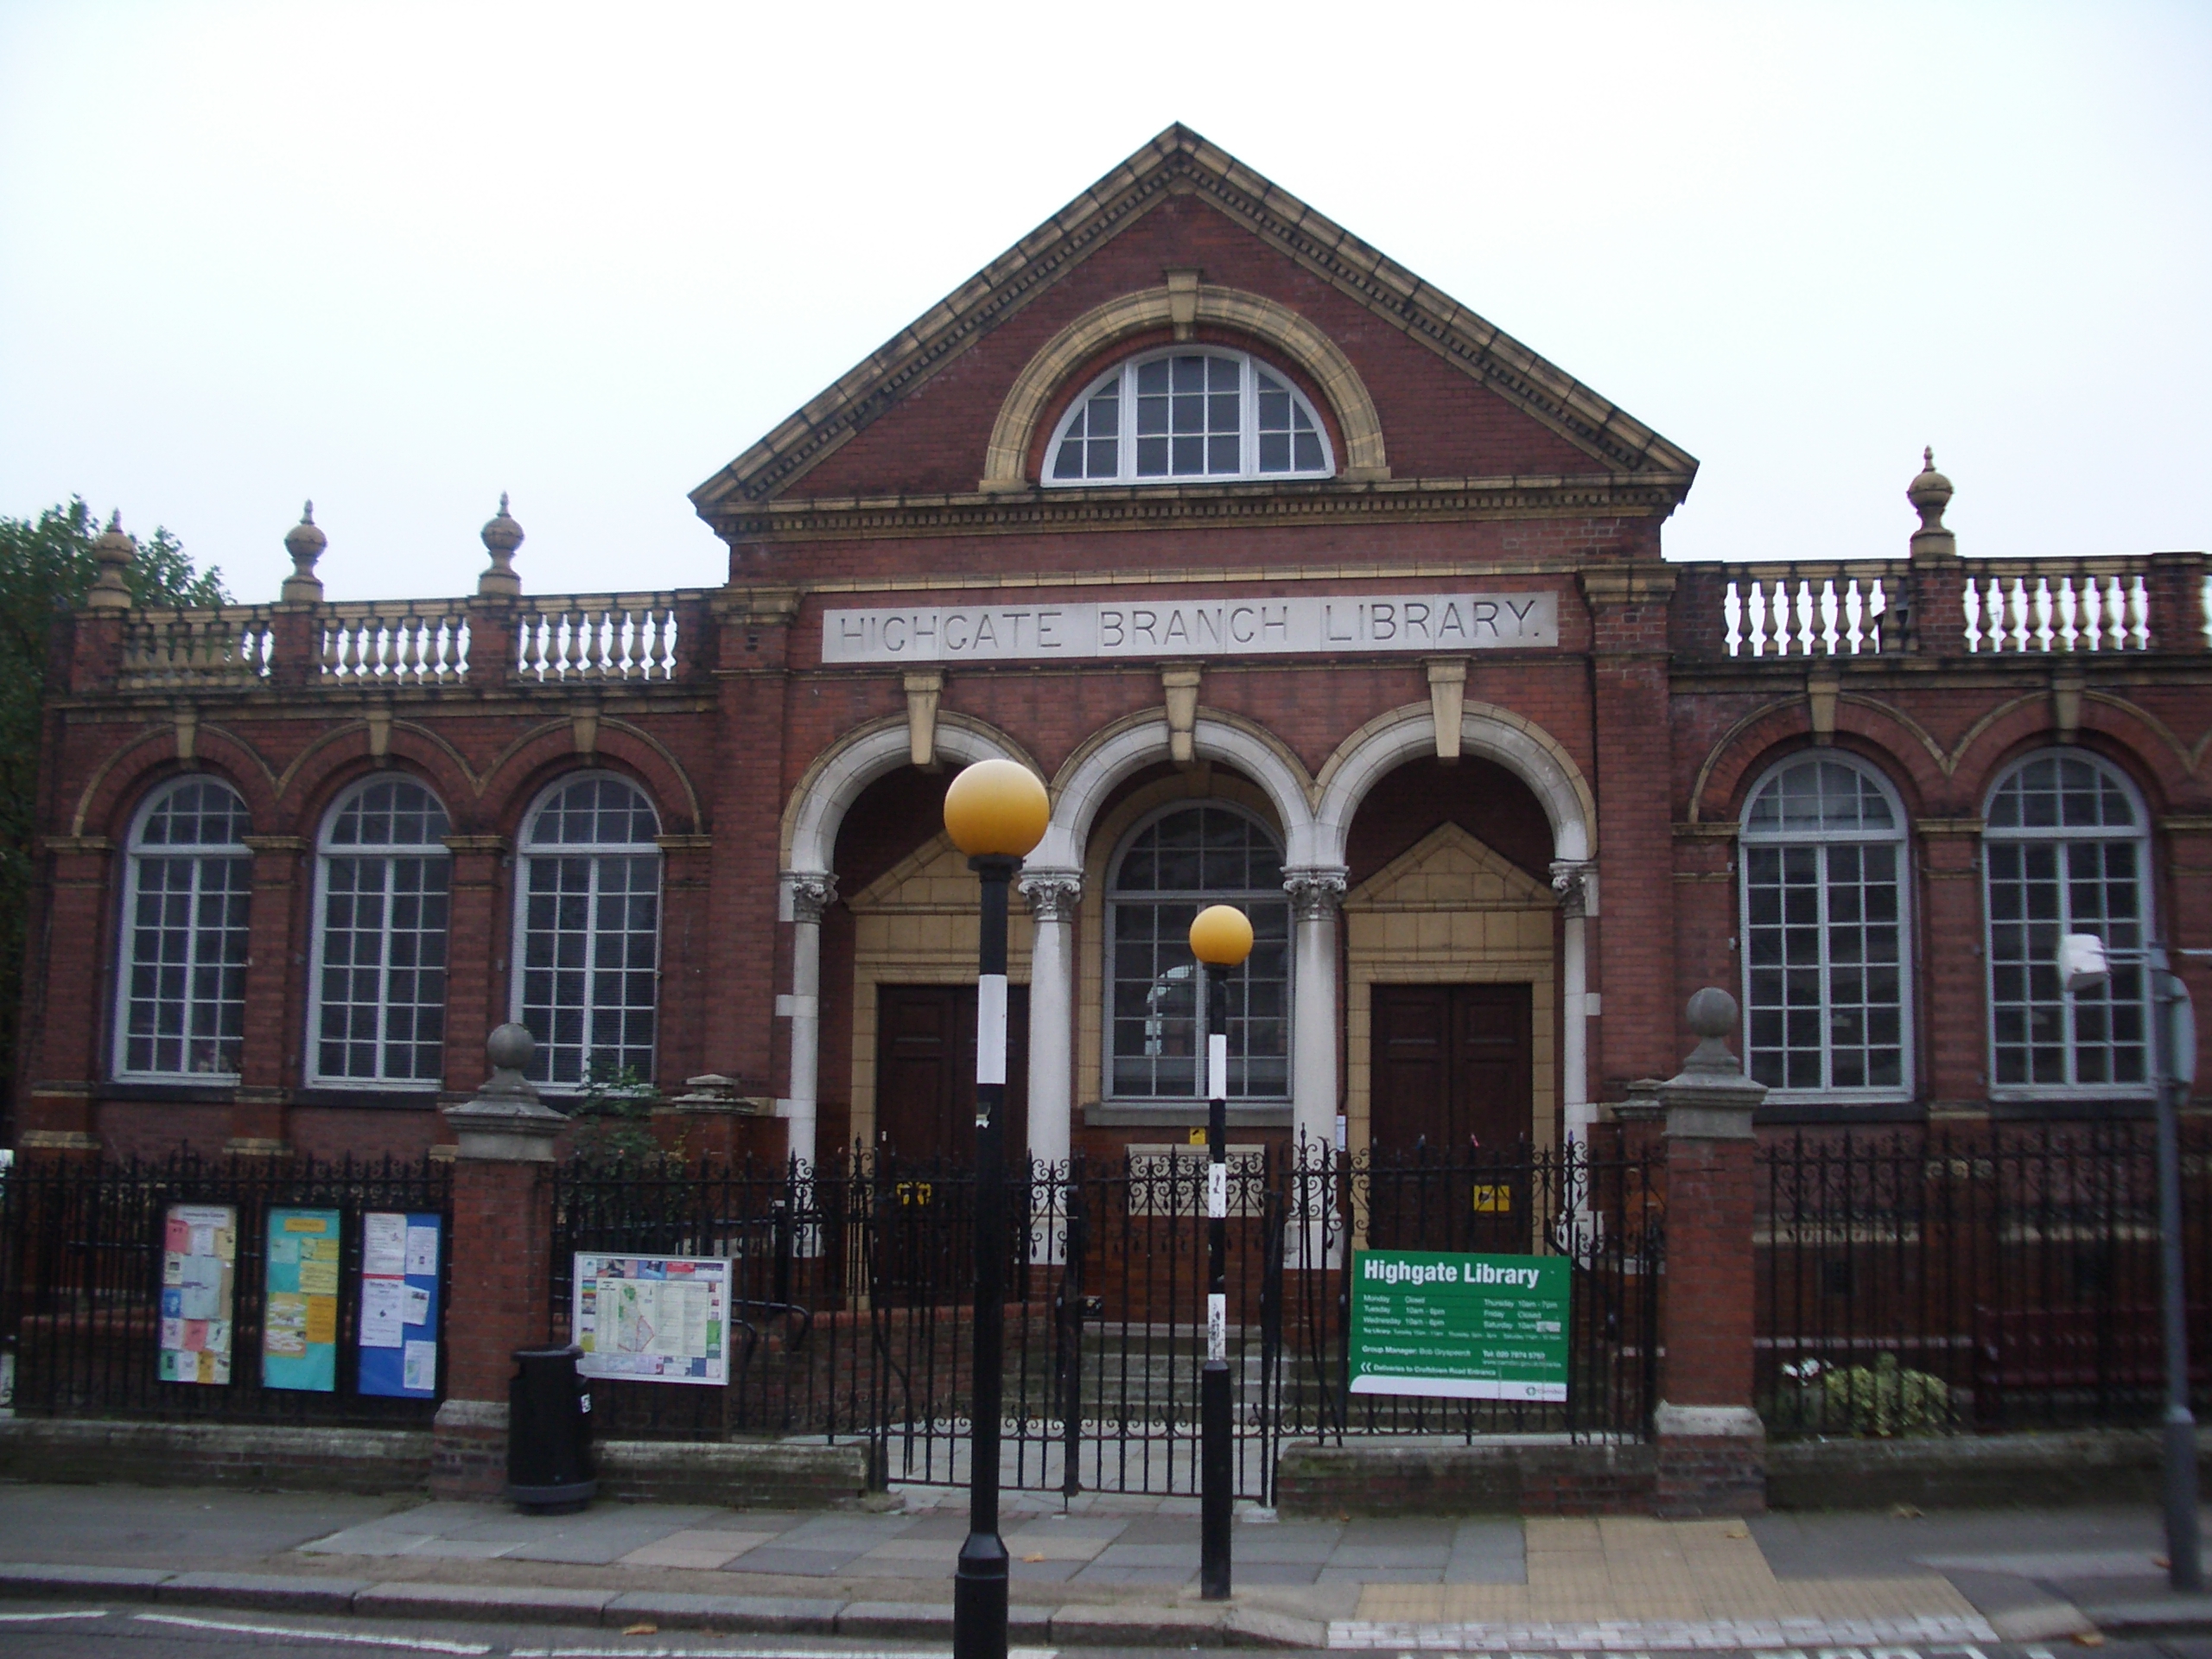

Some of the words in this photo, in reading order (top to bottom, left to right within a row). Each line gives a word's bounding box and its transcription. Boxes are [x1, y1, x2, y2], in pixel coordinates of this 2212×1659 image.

[841, 612, 1062, 652] HIGHGATE
[1101, 605, 1288, 646] BRANCH
[1364, 1259, 1458, 1286] Highgate
[1464, 1262, 1540, 1289] Library
[1363, 1294, 1390, 1303] Monday
[1405, 1295, 1425, 1304] Closed
[1484, 1299, 1514, 1308] Thursday
[1364, 1305, 1391, 1313] Tuesday
[1484, 1309, 1505, 1319] Friday
[1363, 1317, 1402, 1325] Wednesday
[1483, 1320, 1513, 1330] Saturday
[1362, 1344, 1384, 1353] Group
